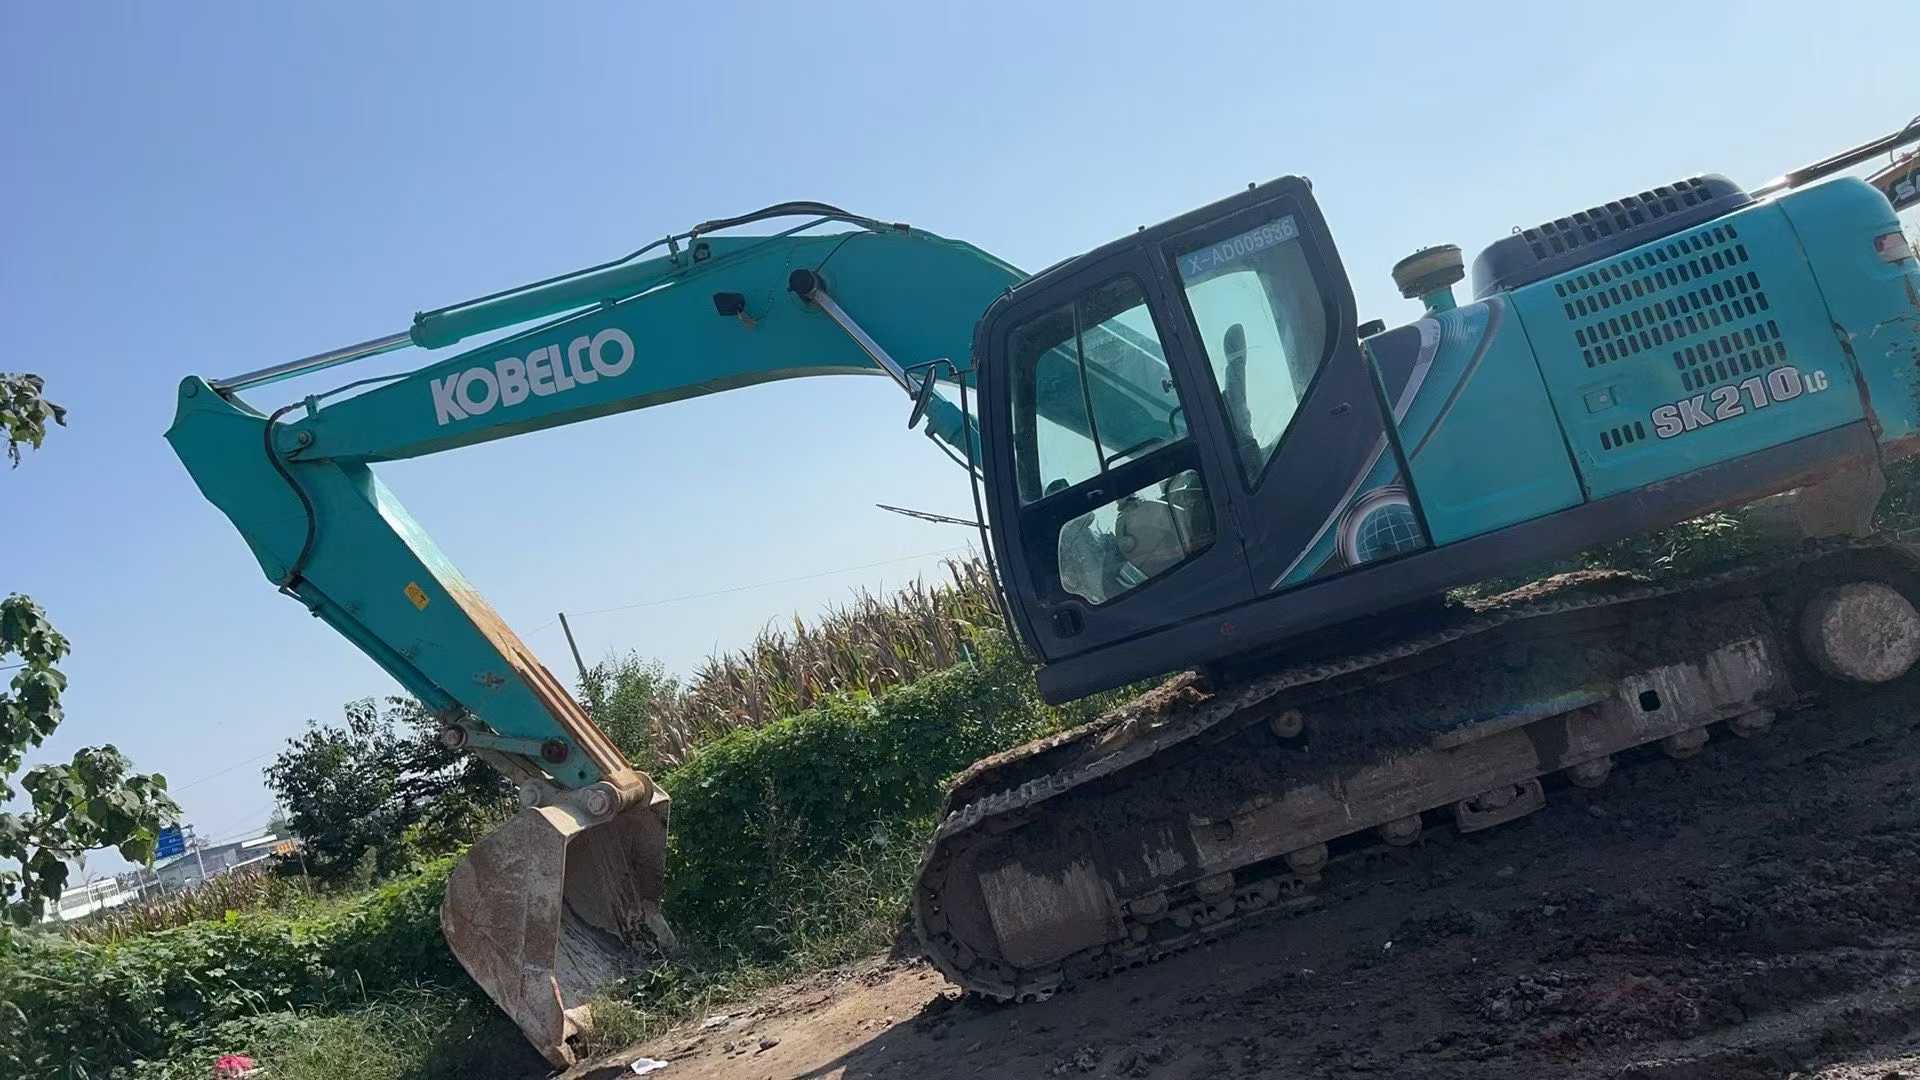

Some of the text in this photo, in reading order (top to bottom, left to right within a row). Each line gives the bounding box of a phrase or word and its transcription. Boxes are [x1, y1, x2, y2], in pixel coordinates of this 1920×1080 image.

[430, 328, 635, 426] KOBELCO
[1651, 366, 1829, 439] SK210 LC
